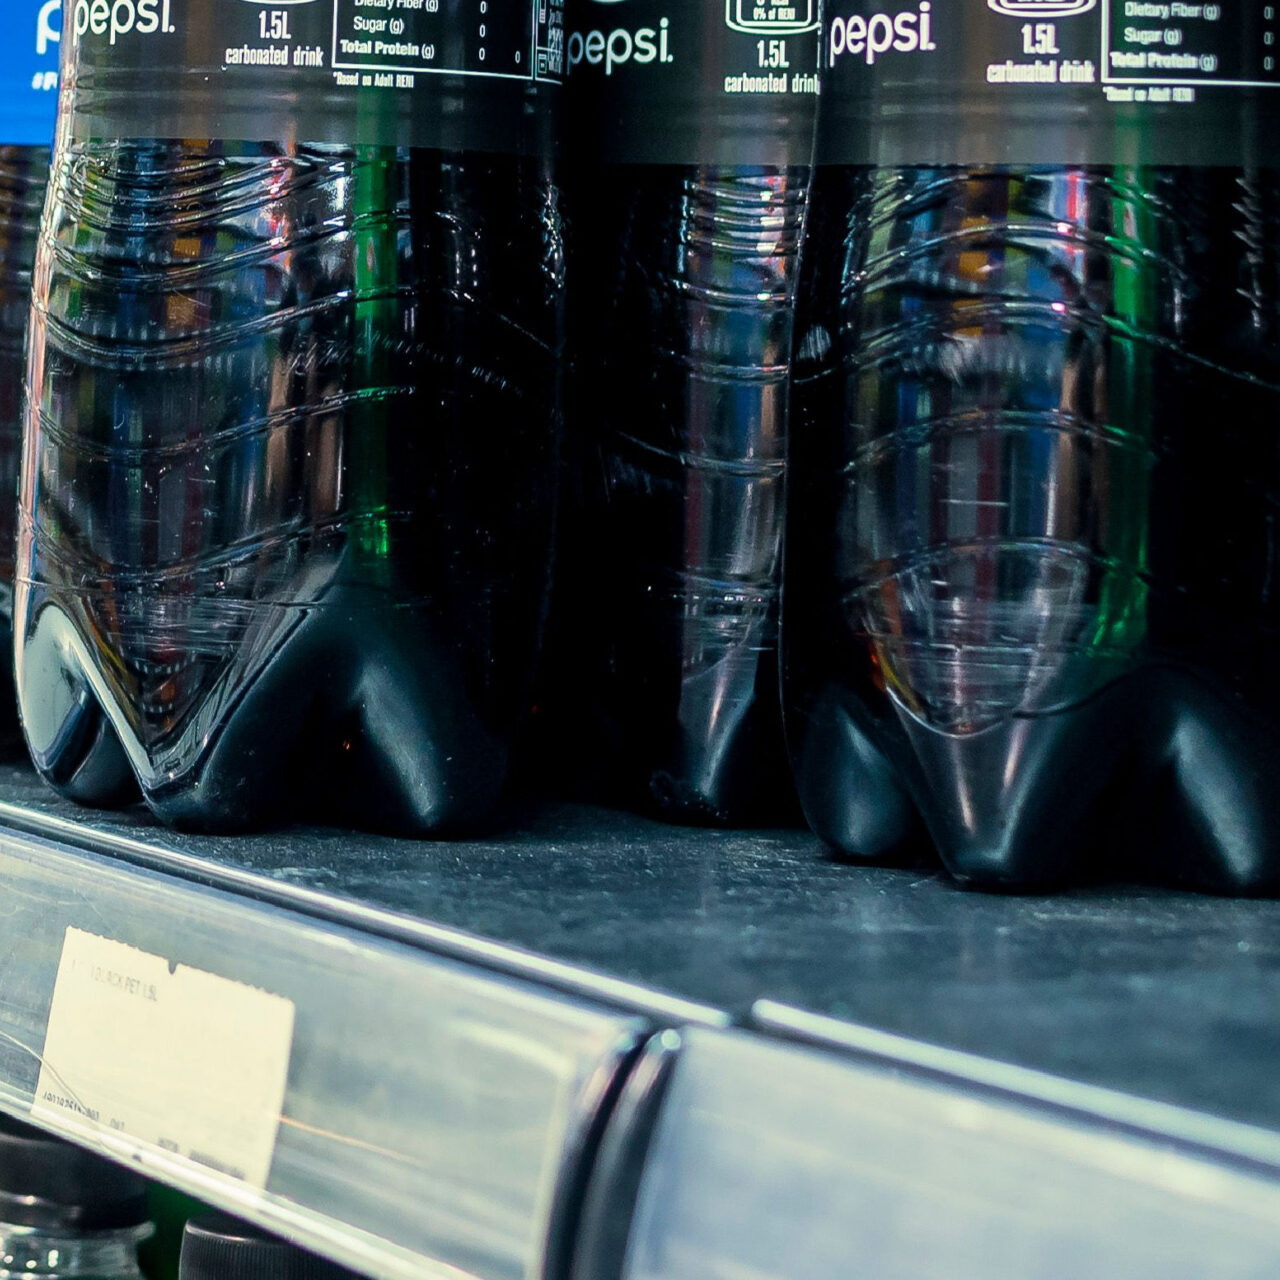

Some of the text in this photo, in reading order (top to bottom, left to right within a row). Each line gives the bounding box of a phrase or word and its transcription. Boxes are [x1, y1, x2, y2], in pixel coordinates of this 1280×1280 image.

[480, 1, 487, 14] 0
[259, 10, 291, 39] 1.5L
[353, 16, 486, 38] Sugar (g) 0
[225, 44, 324, 66] carbonated drink
[340, 39, 520, 63] Total Protein (g) 0 0
[757, 40, 789, 68] 1.5L
[724, 72, 787, 93] carbonated
